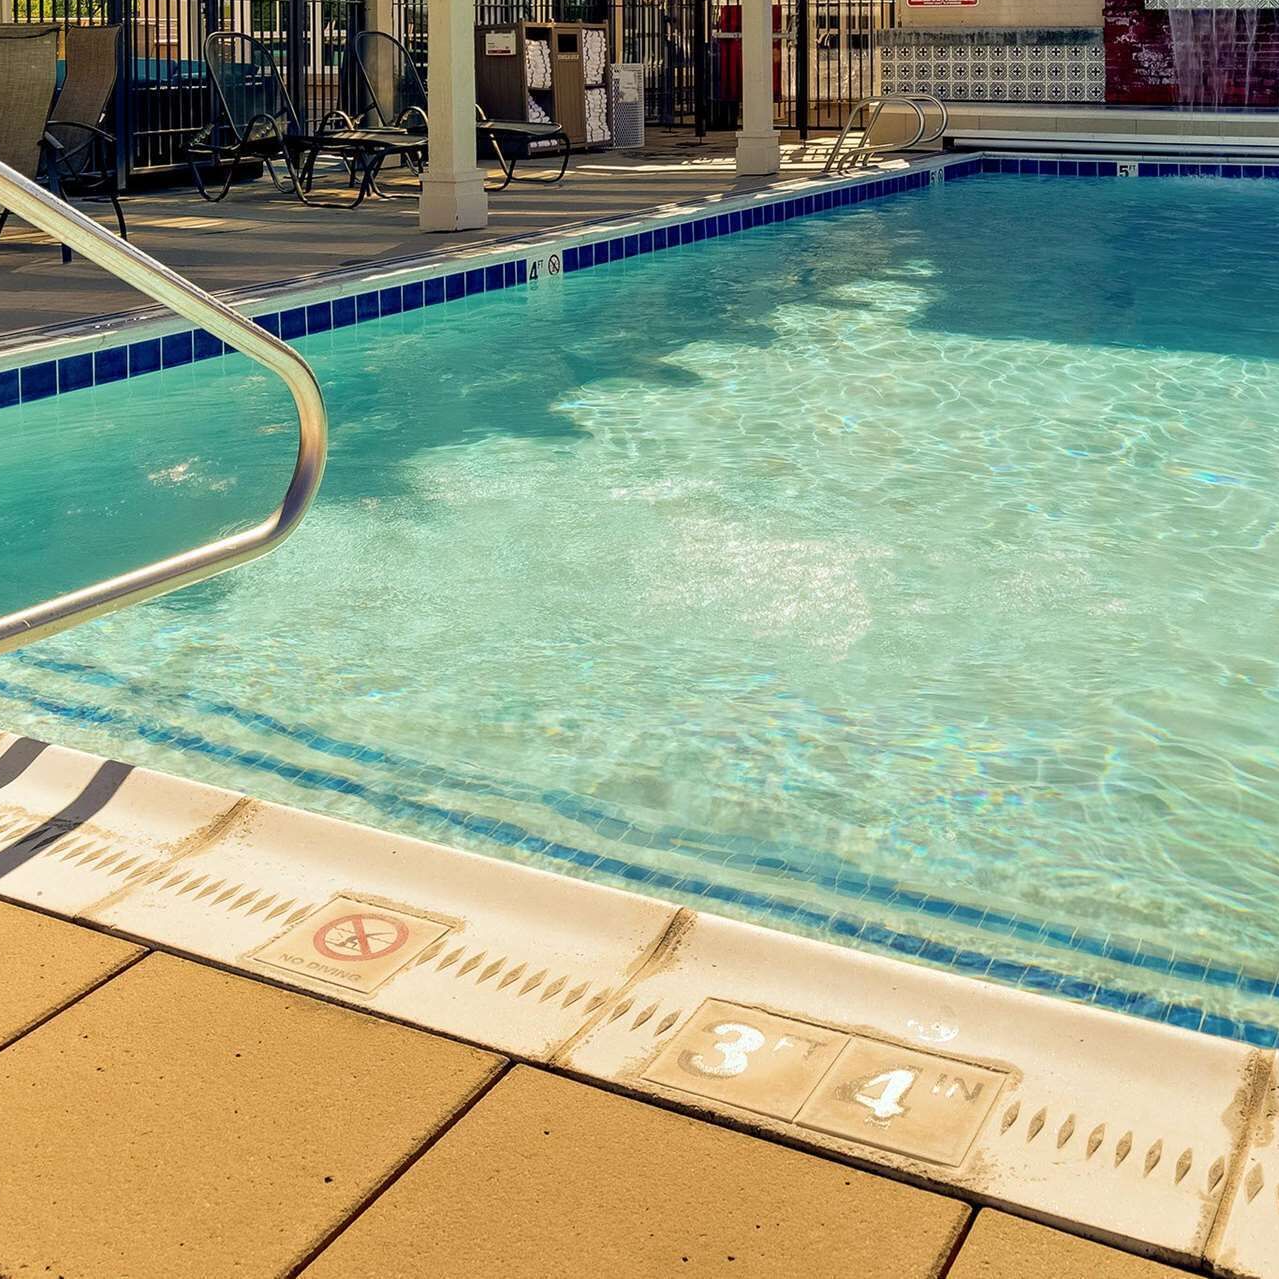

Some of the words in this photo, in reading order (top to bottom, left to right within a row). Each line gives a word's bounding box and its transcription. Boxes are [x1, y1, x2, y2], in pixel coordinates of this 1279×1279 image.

[529, 261, 538, 280] 4
[538, 259, 543, 269] FT
[279, 952, 304, 965] NO
[306, 961, 362, 981] DIVING
[678, 1020, 766, 1078] 3
[838, 1066, 923, 1120] 4
[931, 1072, 984, 1103] IN
